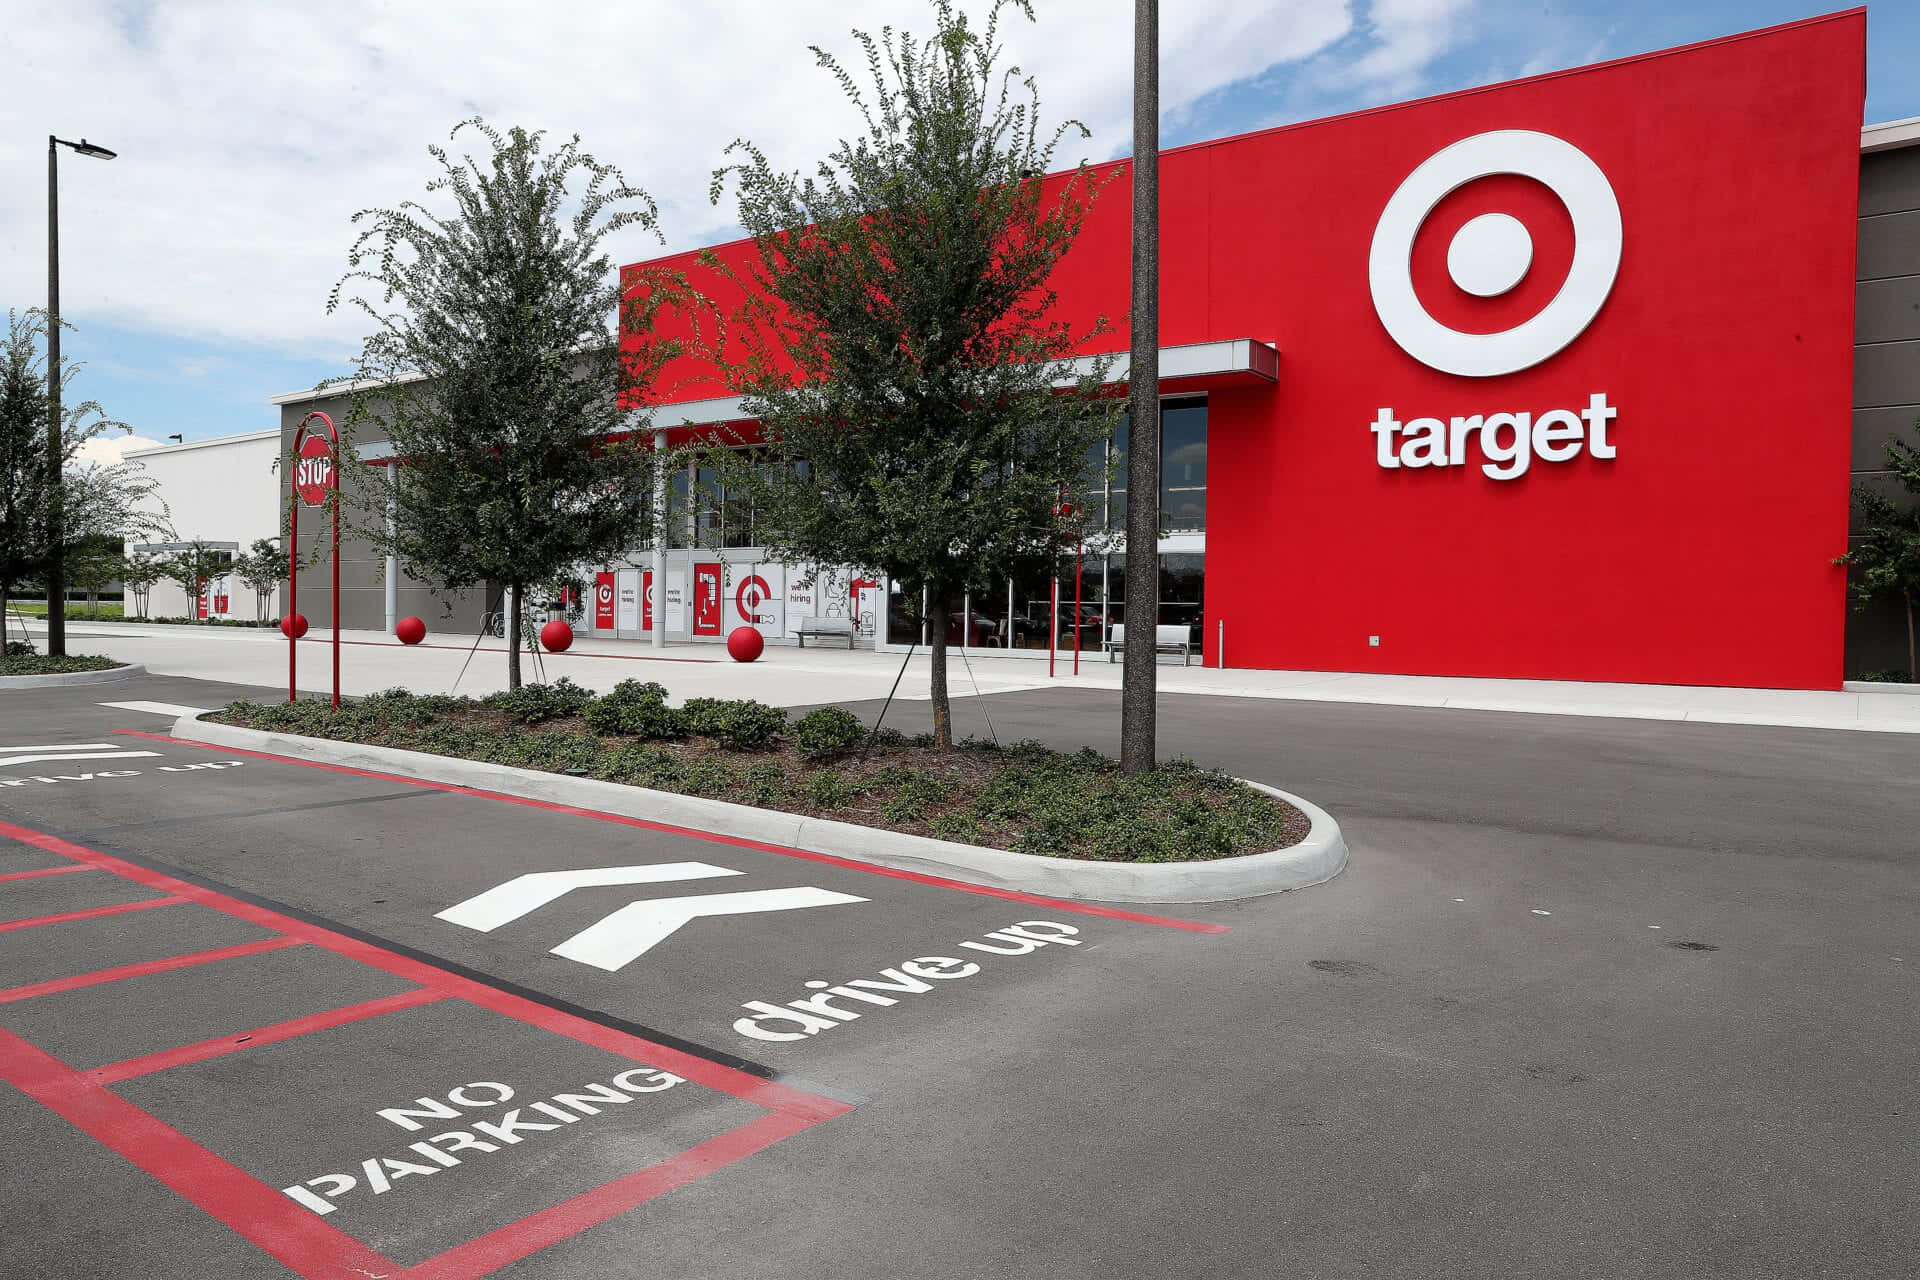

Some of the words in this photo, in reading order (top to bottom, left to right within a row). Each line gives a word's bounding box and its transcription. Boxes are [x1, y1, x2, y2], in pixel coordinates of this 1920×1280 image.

[1370, 393, 1617, 480] target
[298, 456, 331, 486] STOP
[790, 593, 811, 604] hiring
[0, 769, 143, 788] rive
[157, 760, 244, 772] up
[733, 956, 981, 1042] drive
[958, 921, 1082, 956] up
[375, 1082, 515, 1131] NO
[282, 1068, 686, 1215] PARKING
